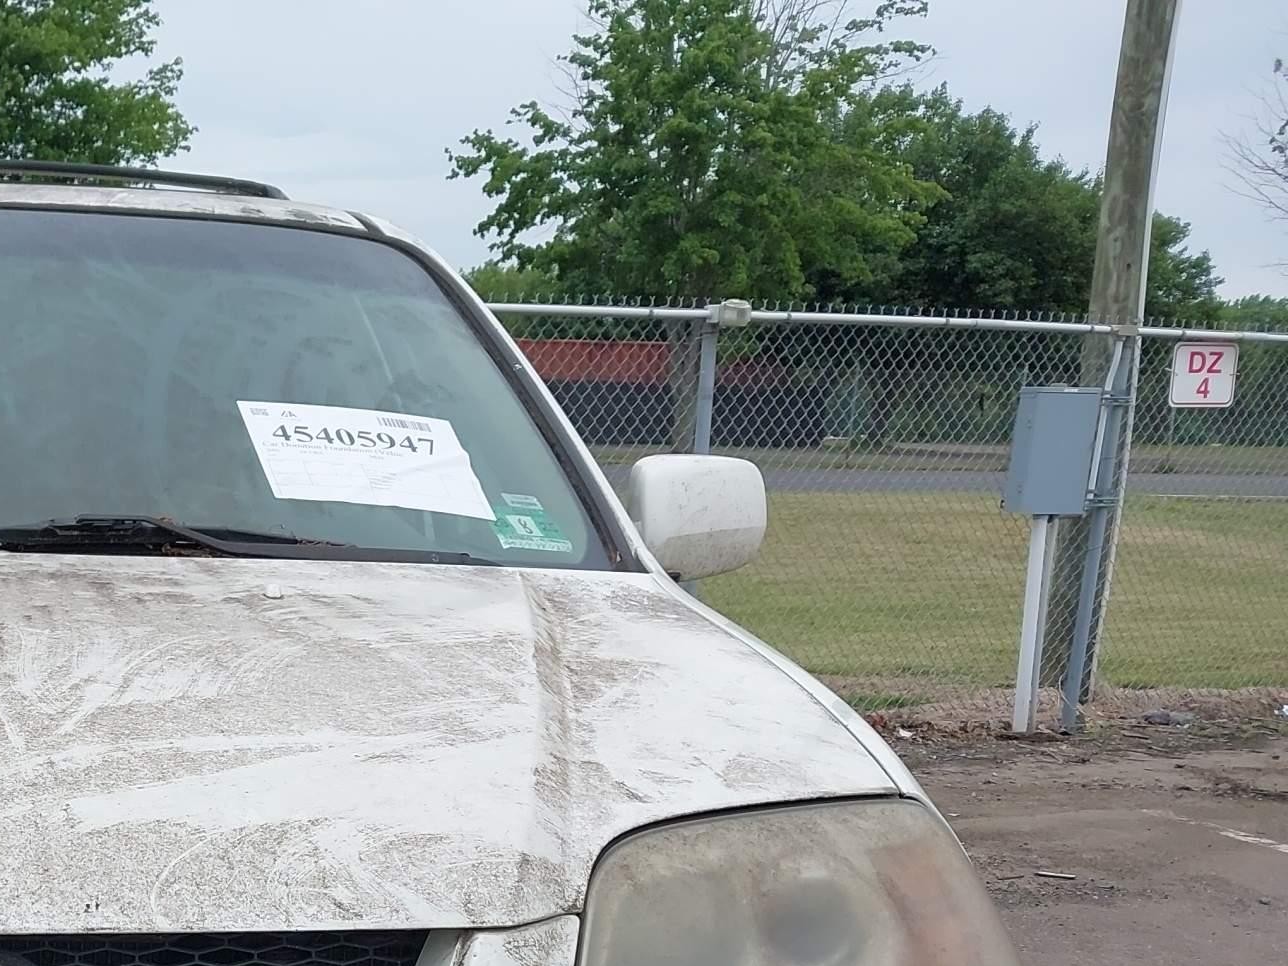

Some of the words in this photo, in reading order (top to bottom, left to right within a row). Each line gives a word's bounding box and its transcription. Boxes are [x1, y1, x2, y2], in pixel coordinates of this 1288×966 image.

[1187, 351, 1224, 374] DZ
[1196, 377, 1210, 399] 4
[272, 424, 434, 455] 45405947
